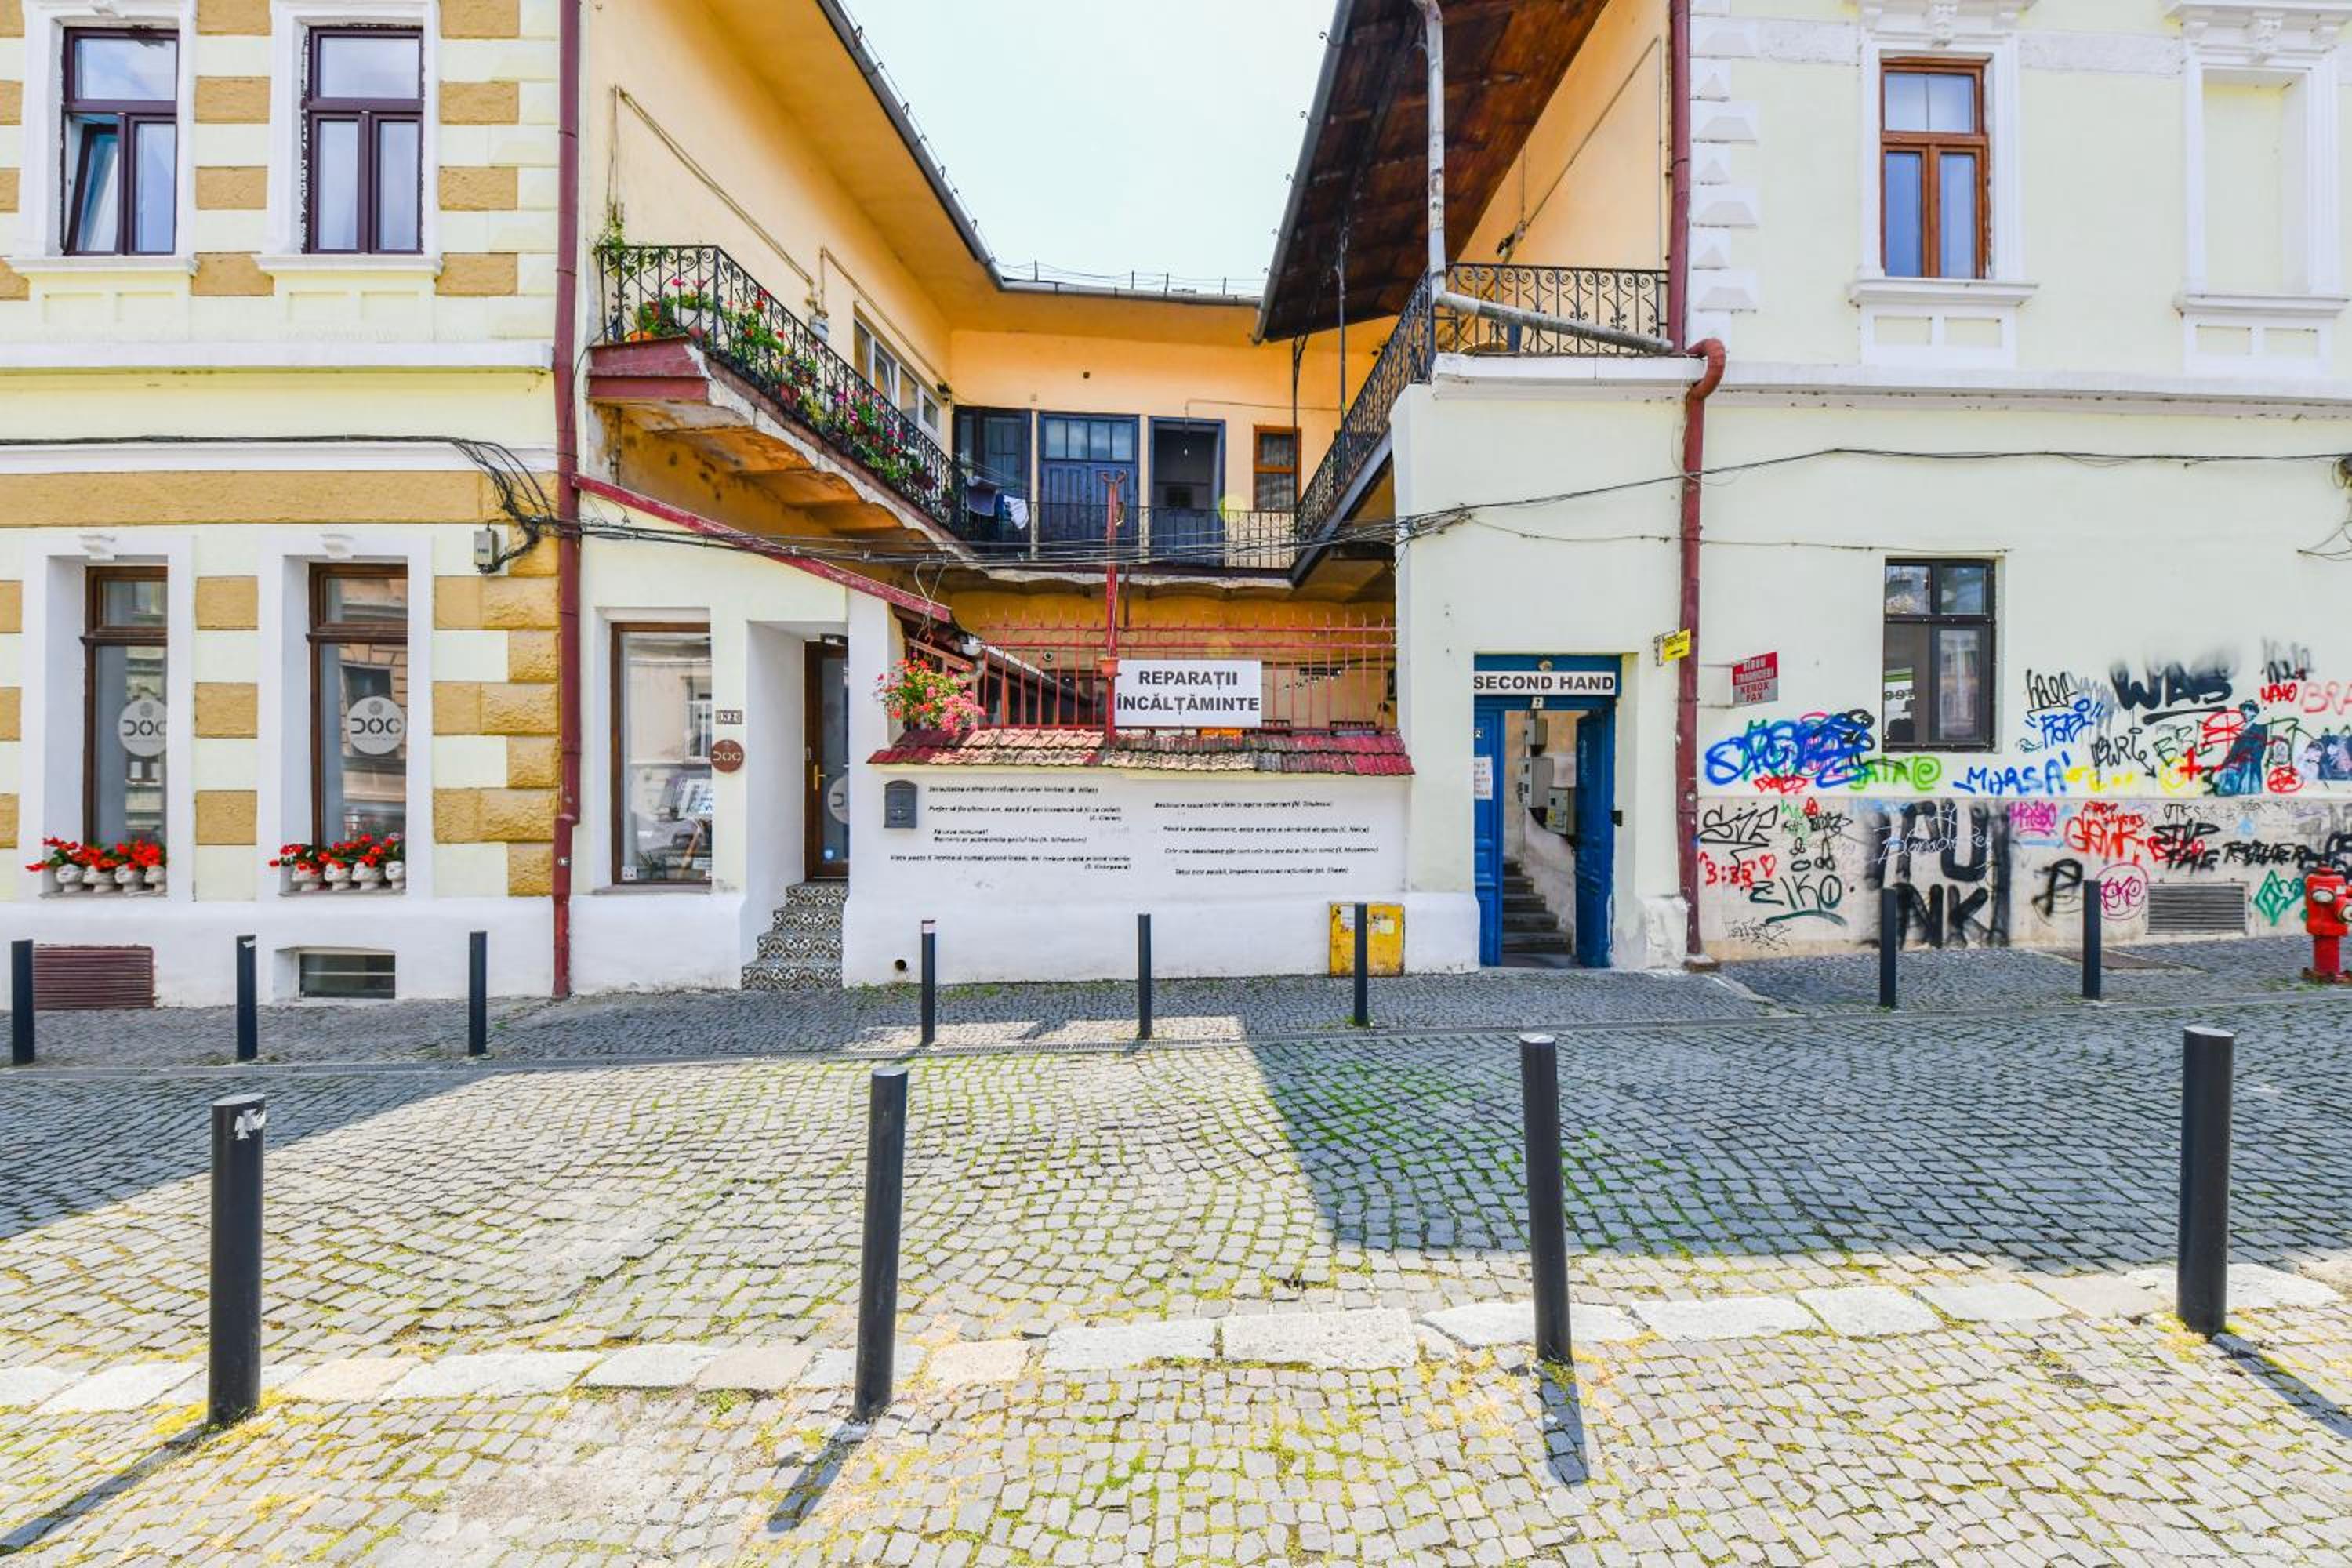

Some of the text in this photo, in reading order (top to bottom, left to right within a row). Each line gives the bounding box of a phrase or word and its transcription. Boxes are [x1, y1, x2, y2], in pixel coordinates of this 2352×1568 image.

[1138, 671, 1238, 690] REPARAȚII
[1474, 676, 1614, 690] SECOND HAND
[1116, 692, 1260, 715] ÎNCĂLȚĂMINTE
